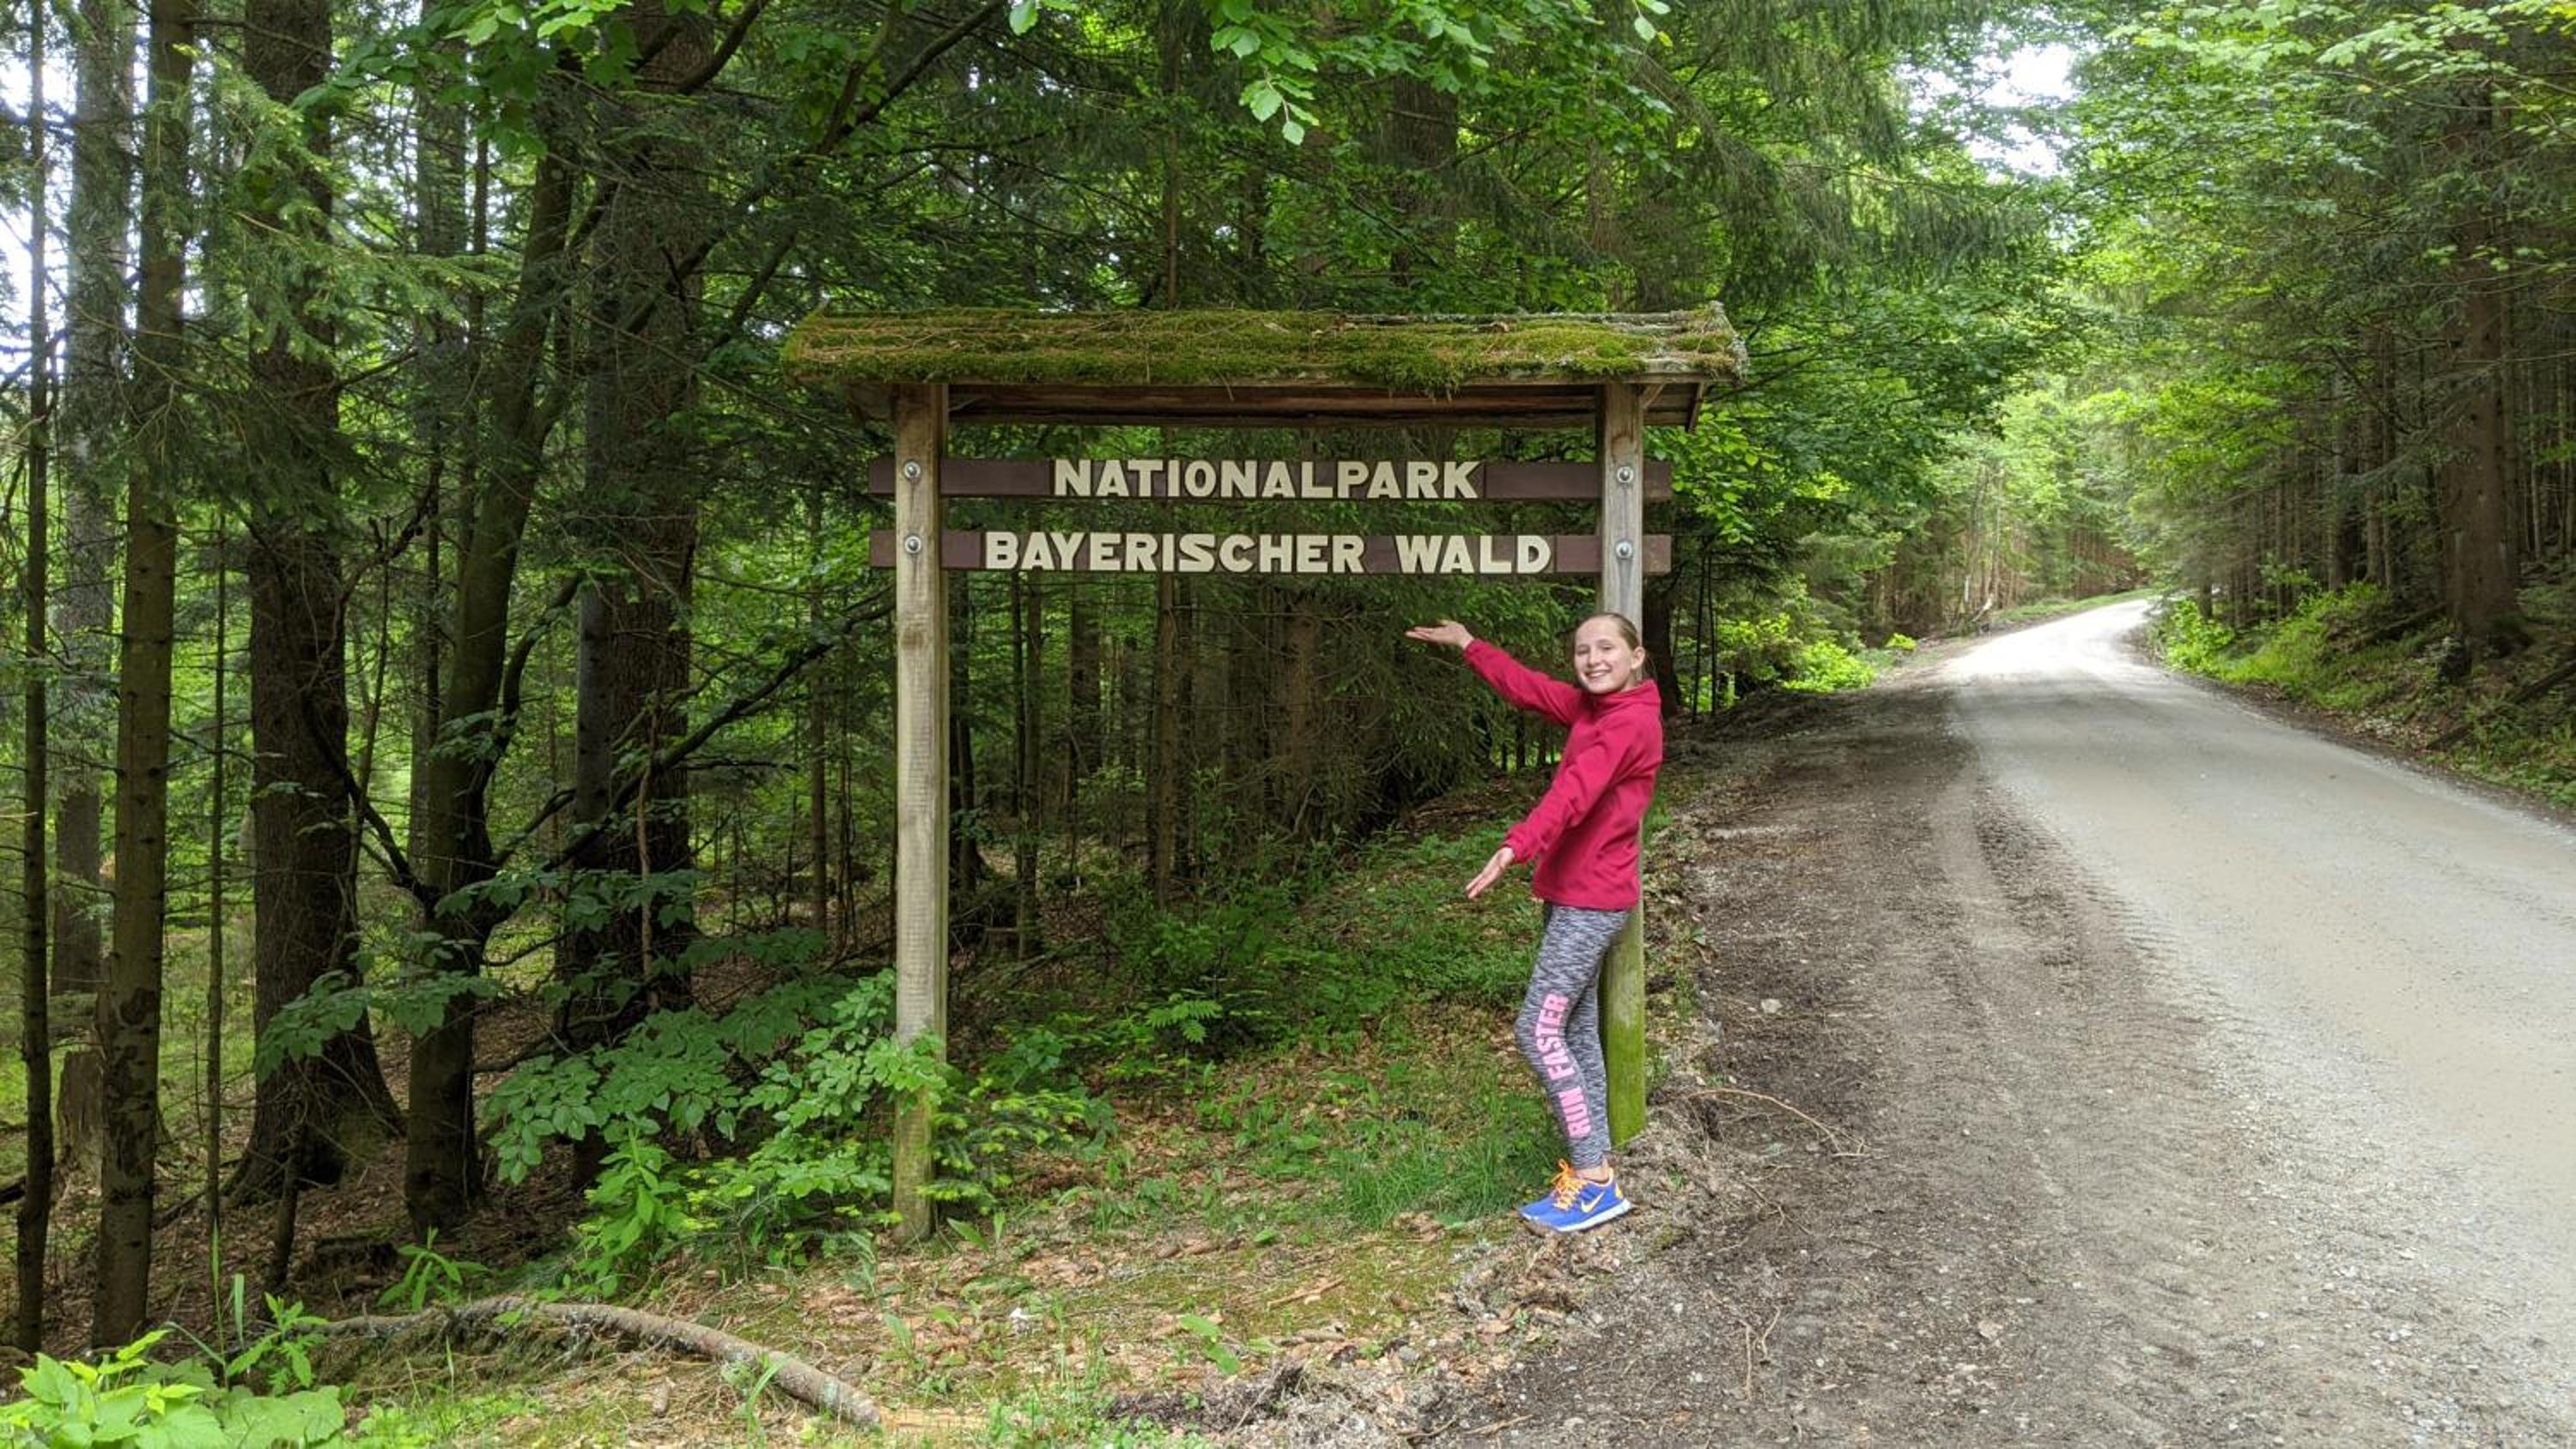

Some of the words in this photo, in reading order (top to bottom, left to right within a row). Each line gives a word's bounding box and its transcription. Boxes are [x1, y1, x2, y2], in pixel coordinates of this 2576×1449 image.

[1054, 459, 1479, 499] NATIONALPARK
[986, 532, 1364, 573] BAYERISCHER
[1395, 534, 1552, 573] WALD
[1535, 992, 1575, 1081] FASTER
[1558, 1087, 1591, 1138] RUN
